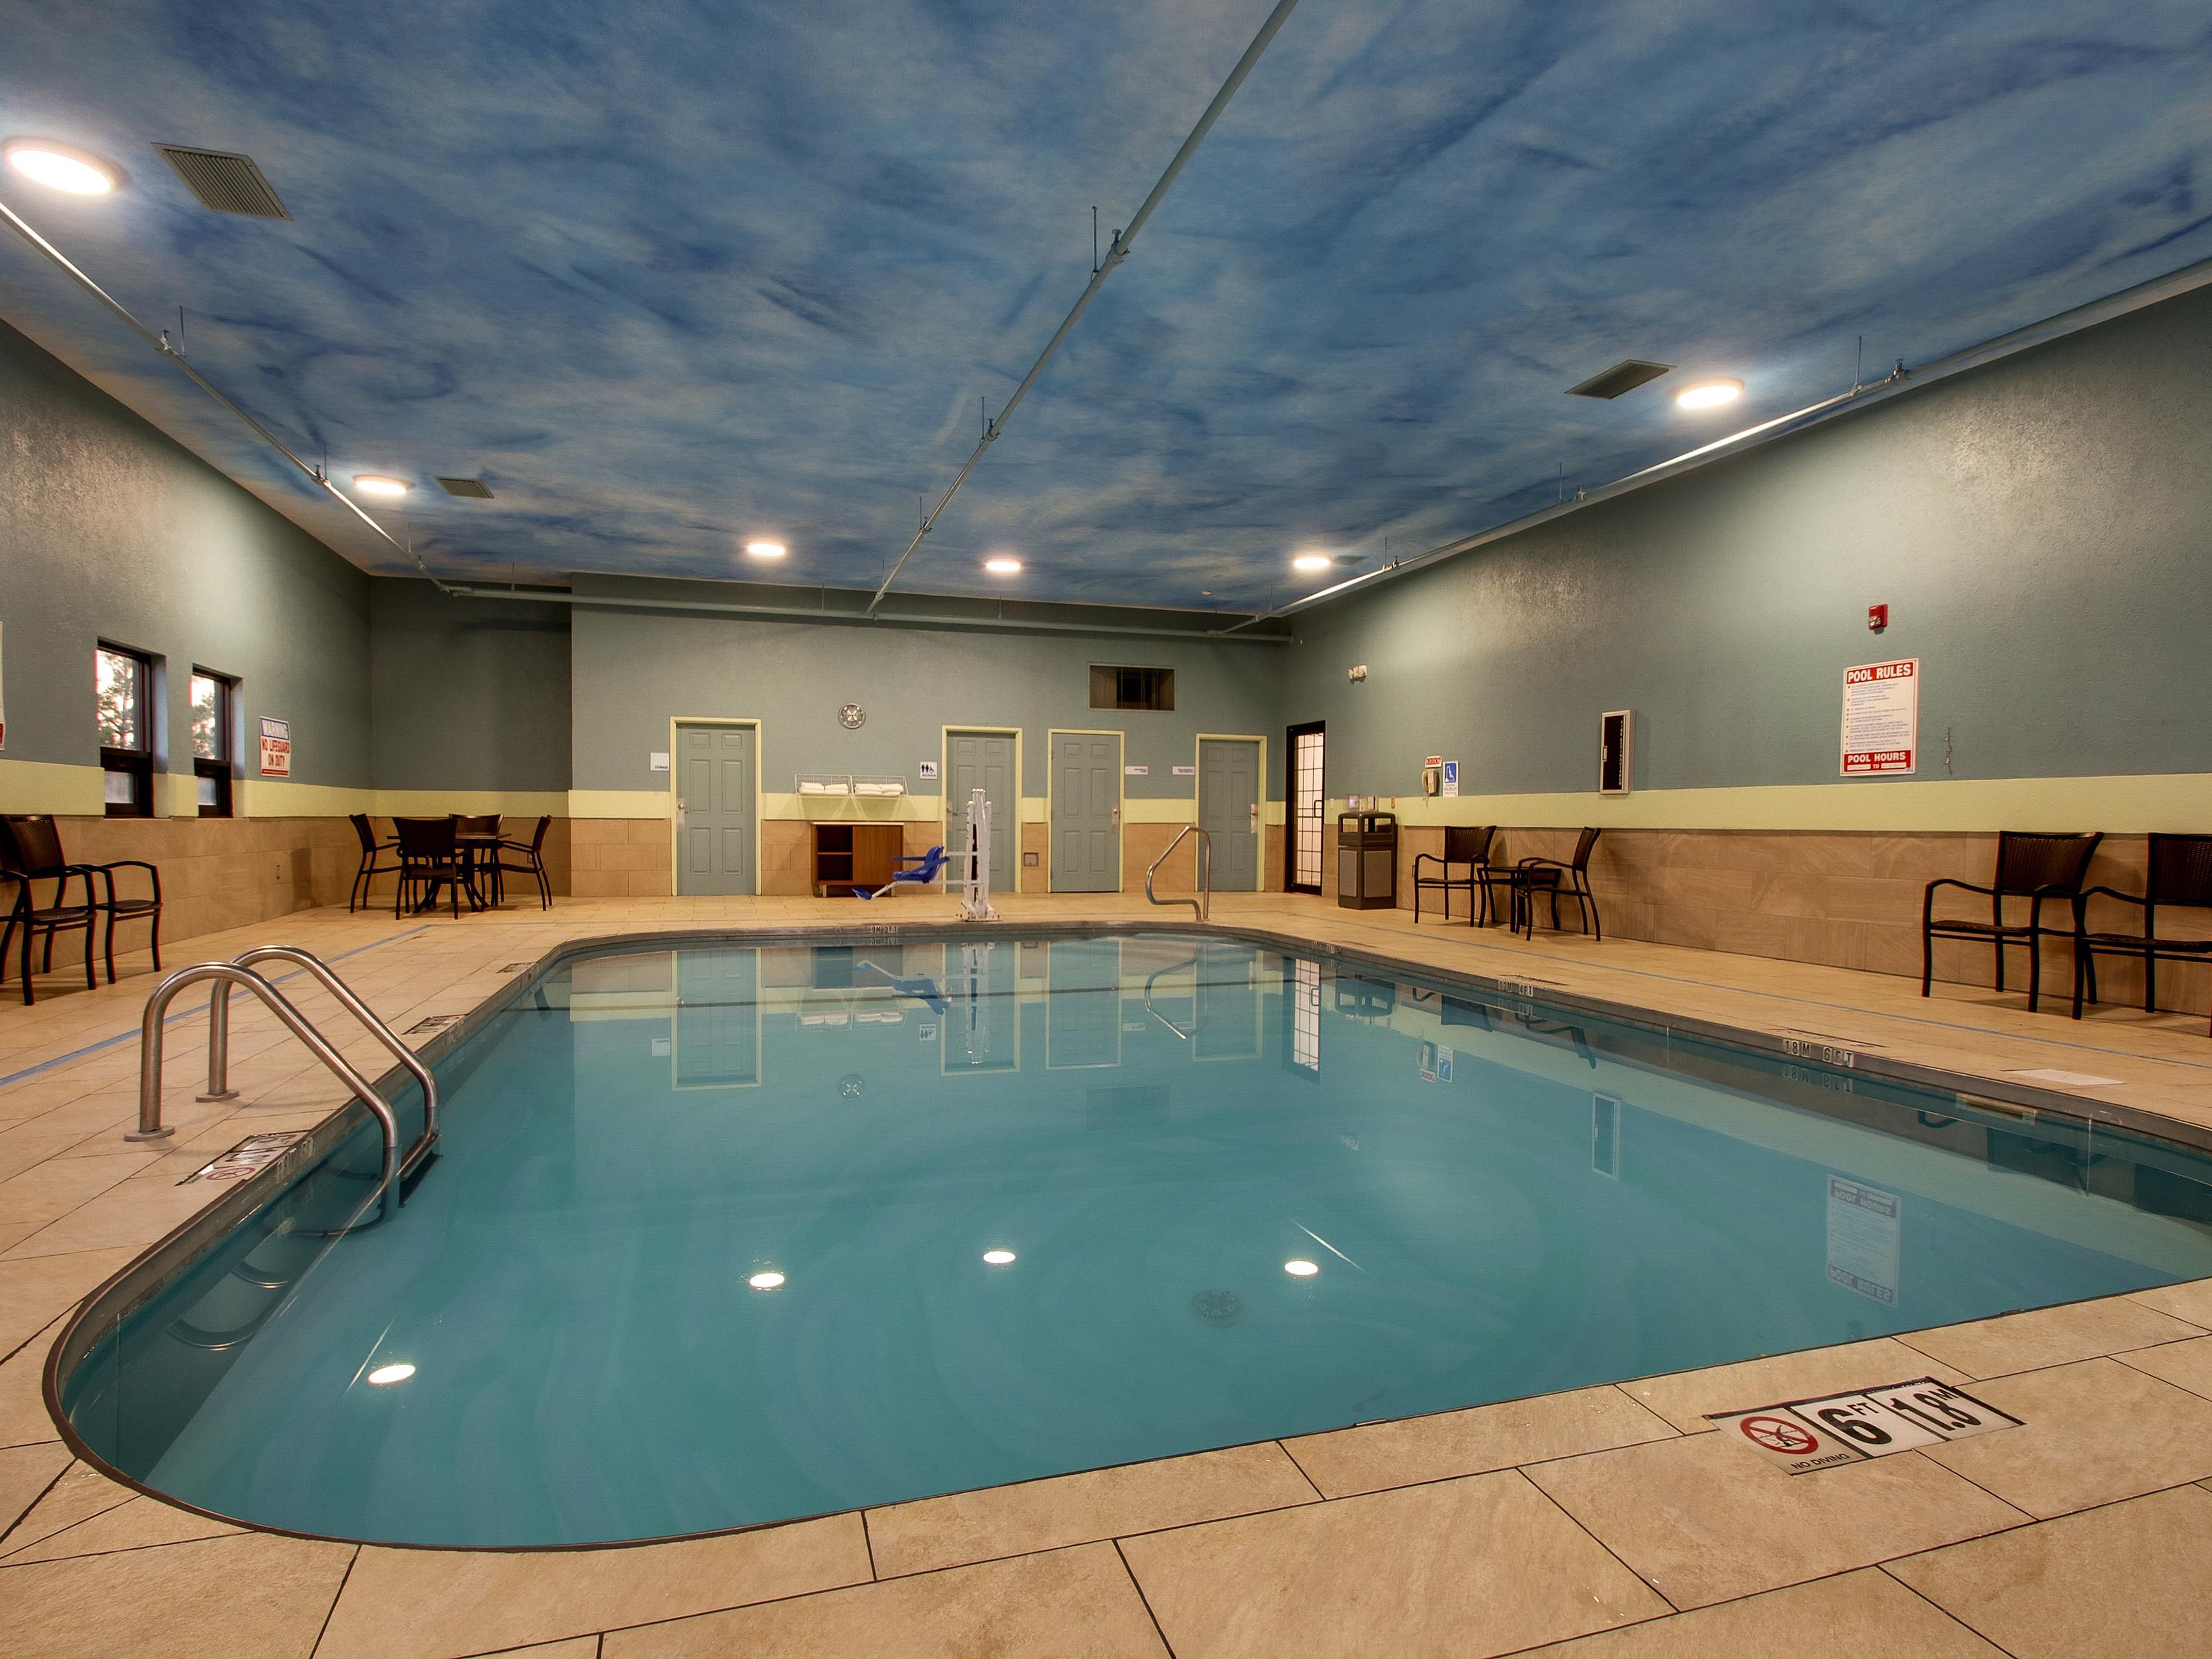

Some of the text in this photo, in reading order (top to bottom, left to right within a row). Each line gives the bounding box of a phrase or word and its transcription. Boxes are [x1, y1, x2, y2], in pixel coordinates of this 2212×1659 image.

[1848, 664, 1911, 683] POOL RULES
[262, 738, 290, 754] NO LIFEGUARD
[268, 754, 285, 767] ON DUTY
[1848, 752, 1906, 763] POOL HOURS
[1791, 1453, 1852, 1470] NO DIVING
